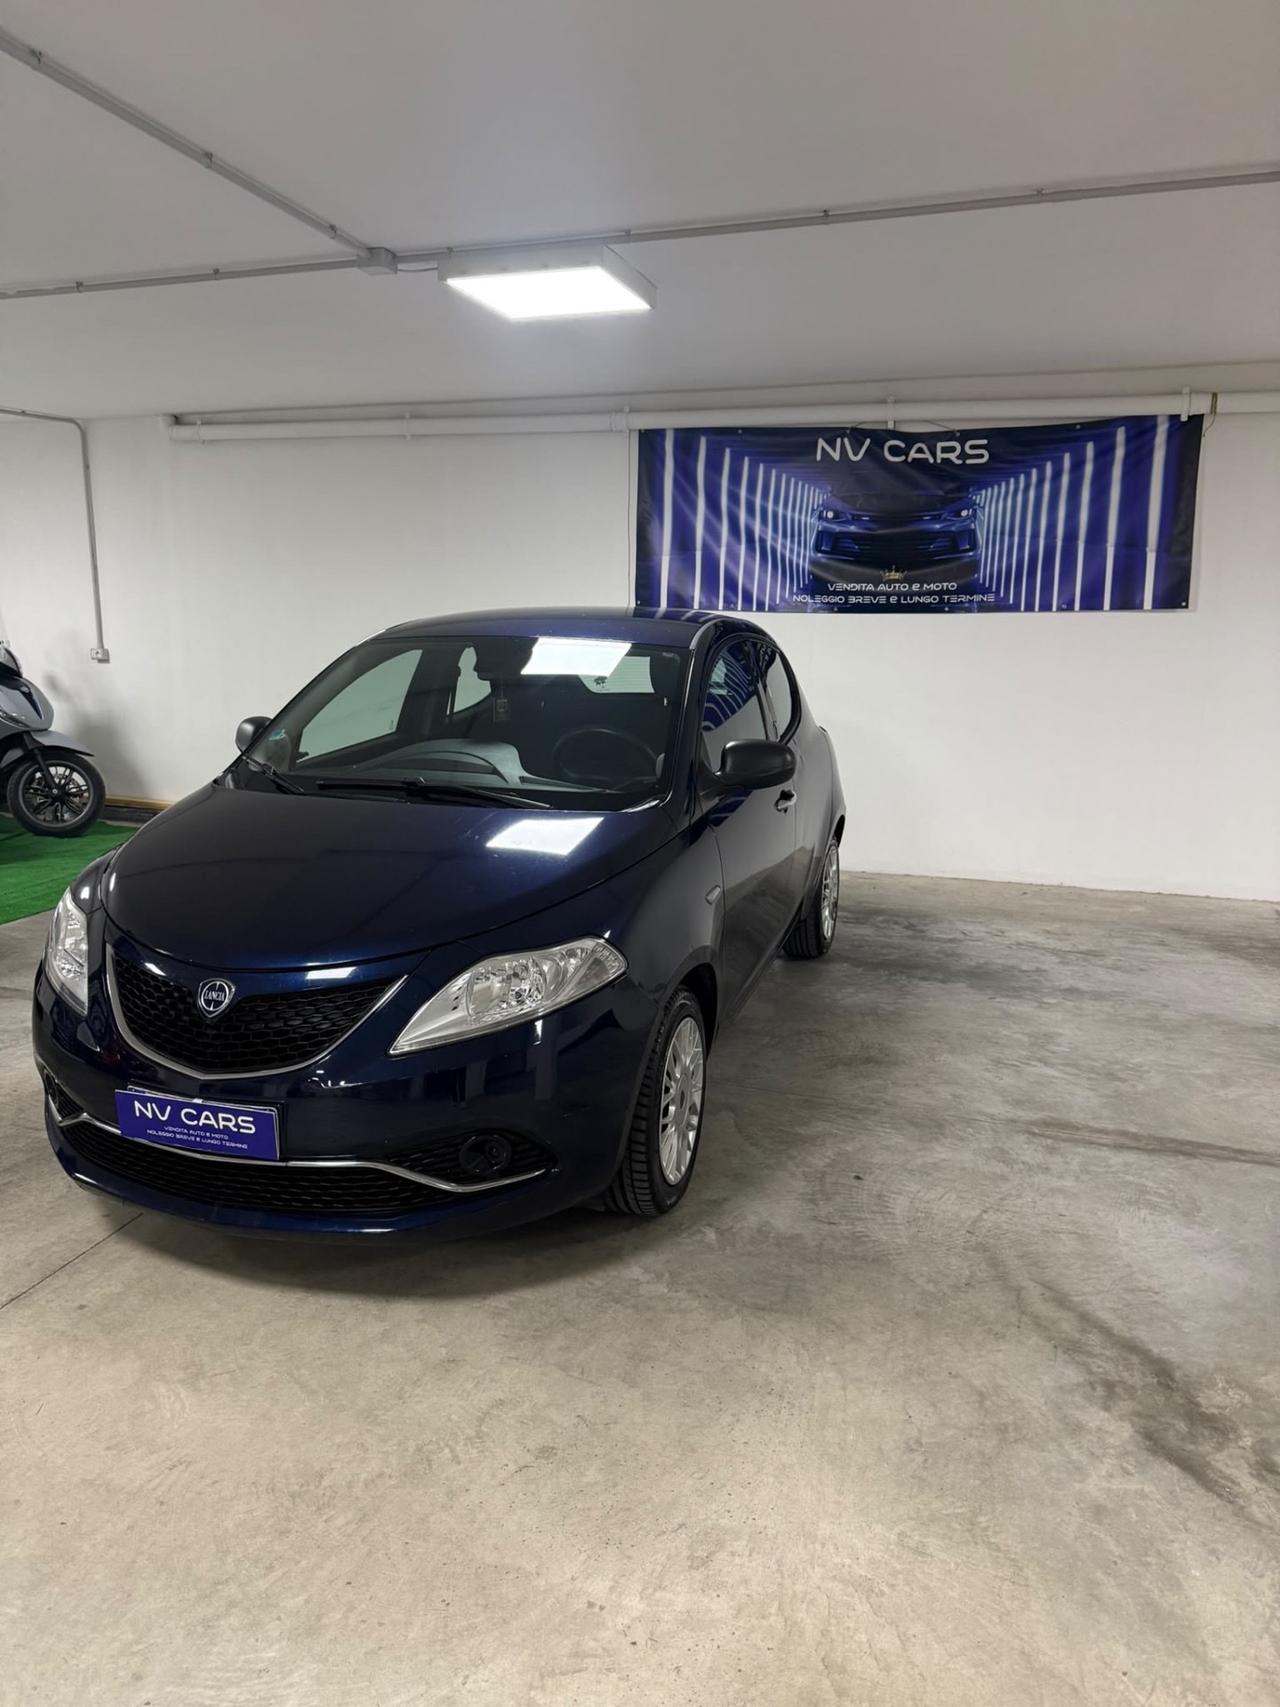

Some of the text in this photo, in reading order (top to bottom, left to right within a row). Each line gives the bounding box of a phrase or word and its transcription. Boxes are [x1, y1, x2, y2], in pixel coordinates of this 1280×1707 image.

[816, 437, 990, 465] NV CARS
[827, 583, 875, 592] VENDITA
[877, 583, 909, 591] AUTO
[923, 582, 958, 591] MOTO
[793, 594, 845, 604] NOLEGGIO
[848, 595, 887, 604] BREVE
[900, 595, 939, 604] LUNGO
[942, 594, 996, 603] TERMINE
[204, 990, 225, 1002] LANCIA
[134, 1100, 256, 1134] NV CARS
[164, 1126, 188, 1134] VENDITA
[201, 1138, 221, 1146] LUNGO
[222, 1141, 248, 1149] TERMINE
